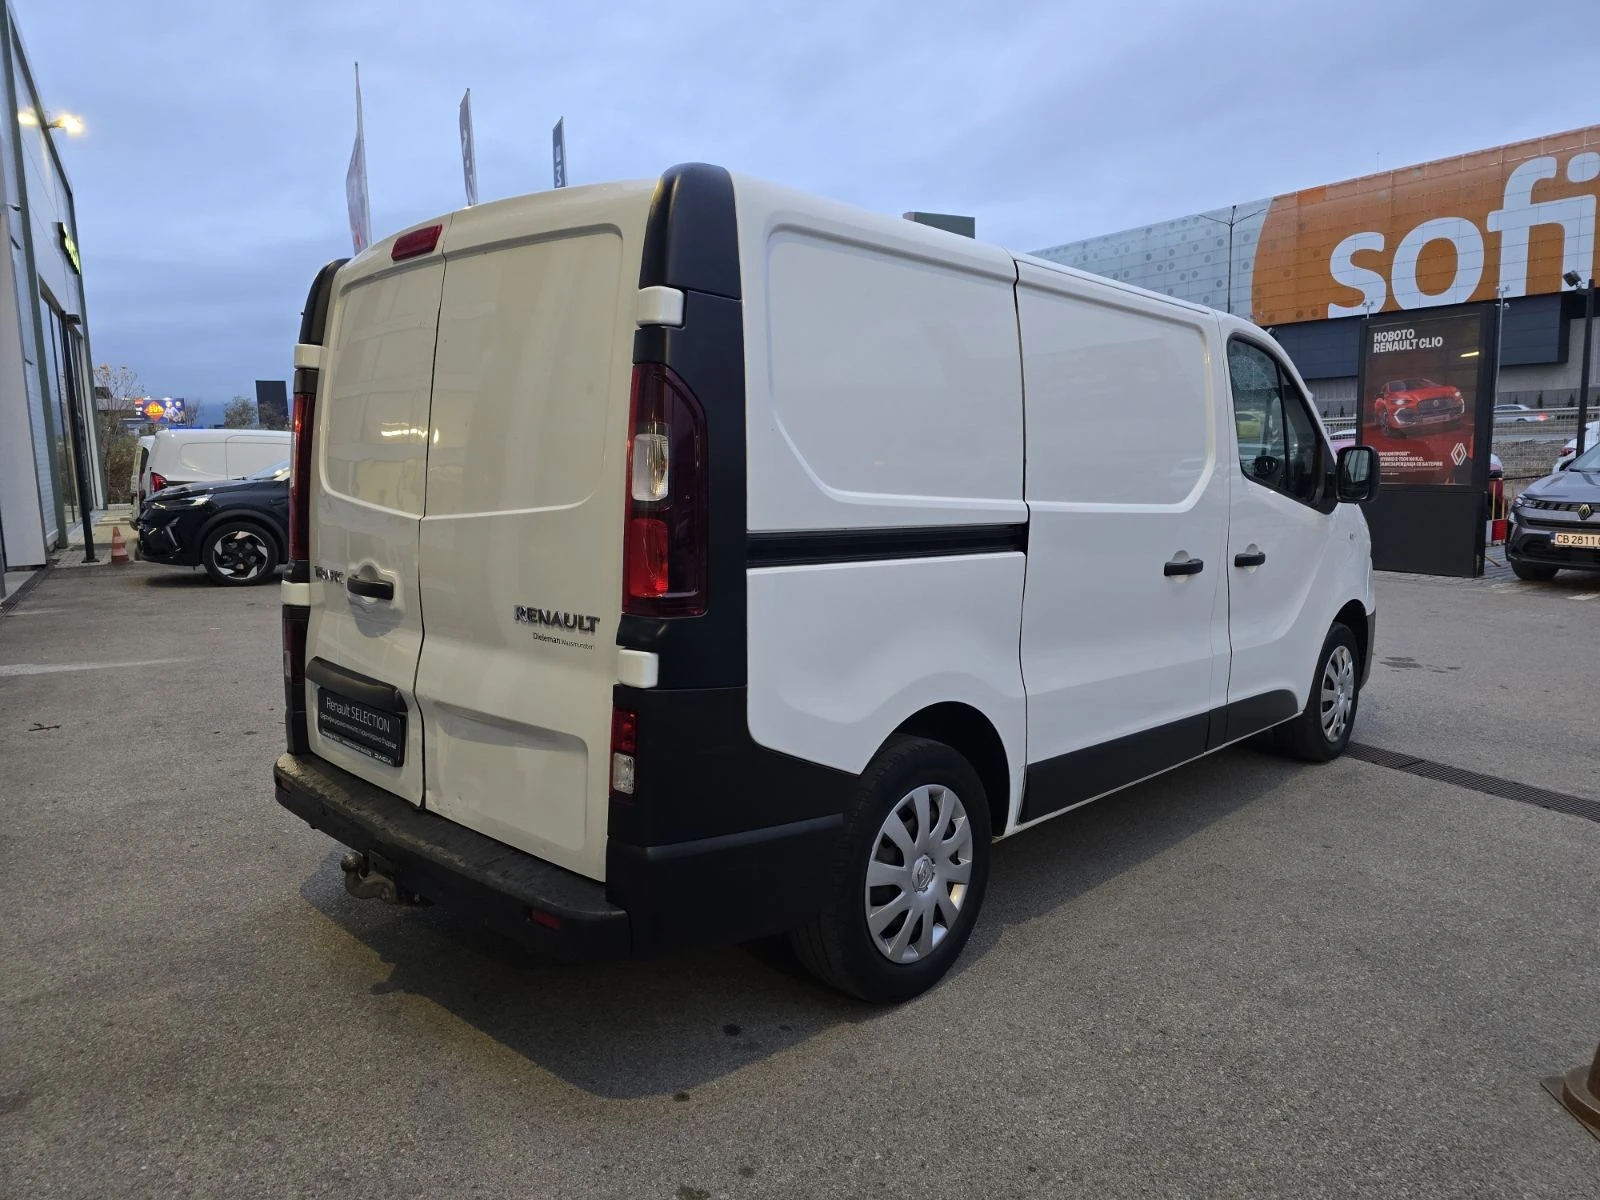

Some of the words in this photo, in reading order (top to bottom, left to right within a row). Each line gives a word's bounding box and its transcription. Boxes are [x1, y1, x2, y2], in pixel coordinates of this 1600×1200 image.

[1374, 329, 1415, 342] НОВОТО
[1373, 339, 1418, 353] RENAULT
[1419, 336, 1443, 349] CLIO
[1556, 534, 1569, 544] CB
[1571, 535, 1595, 545] 2811
[515, 605, 600, 633] RENAULT
[326, 696, 350, 717] Renault
[351, 706, 390, 733] SELECTION
